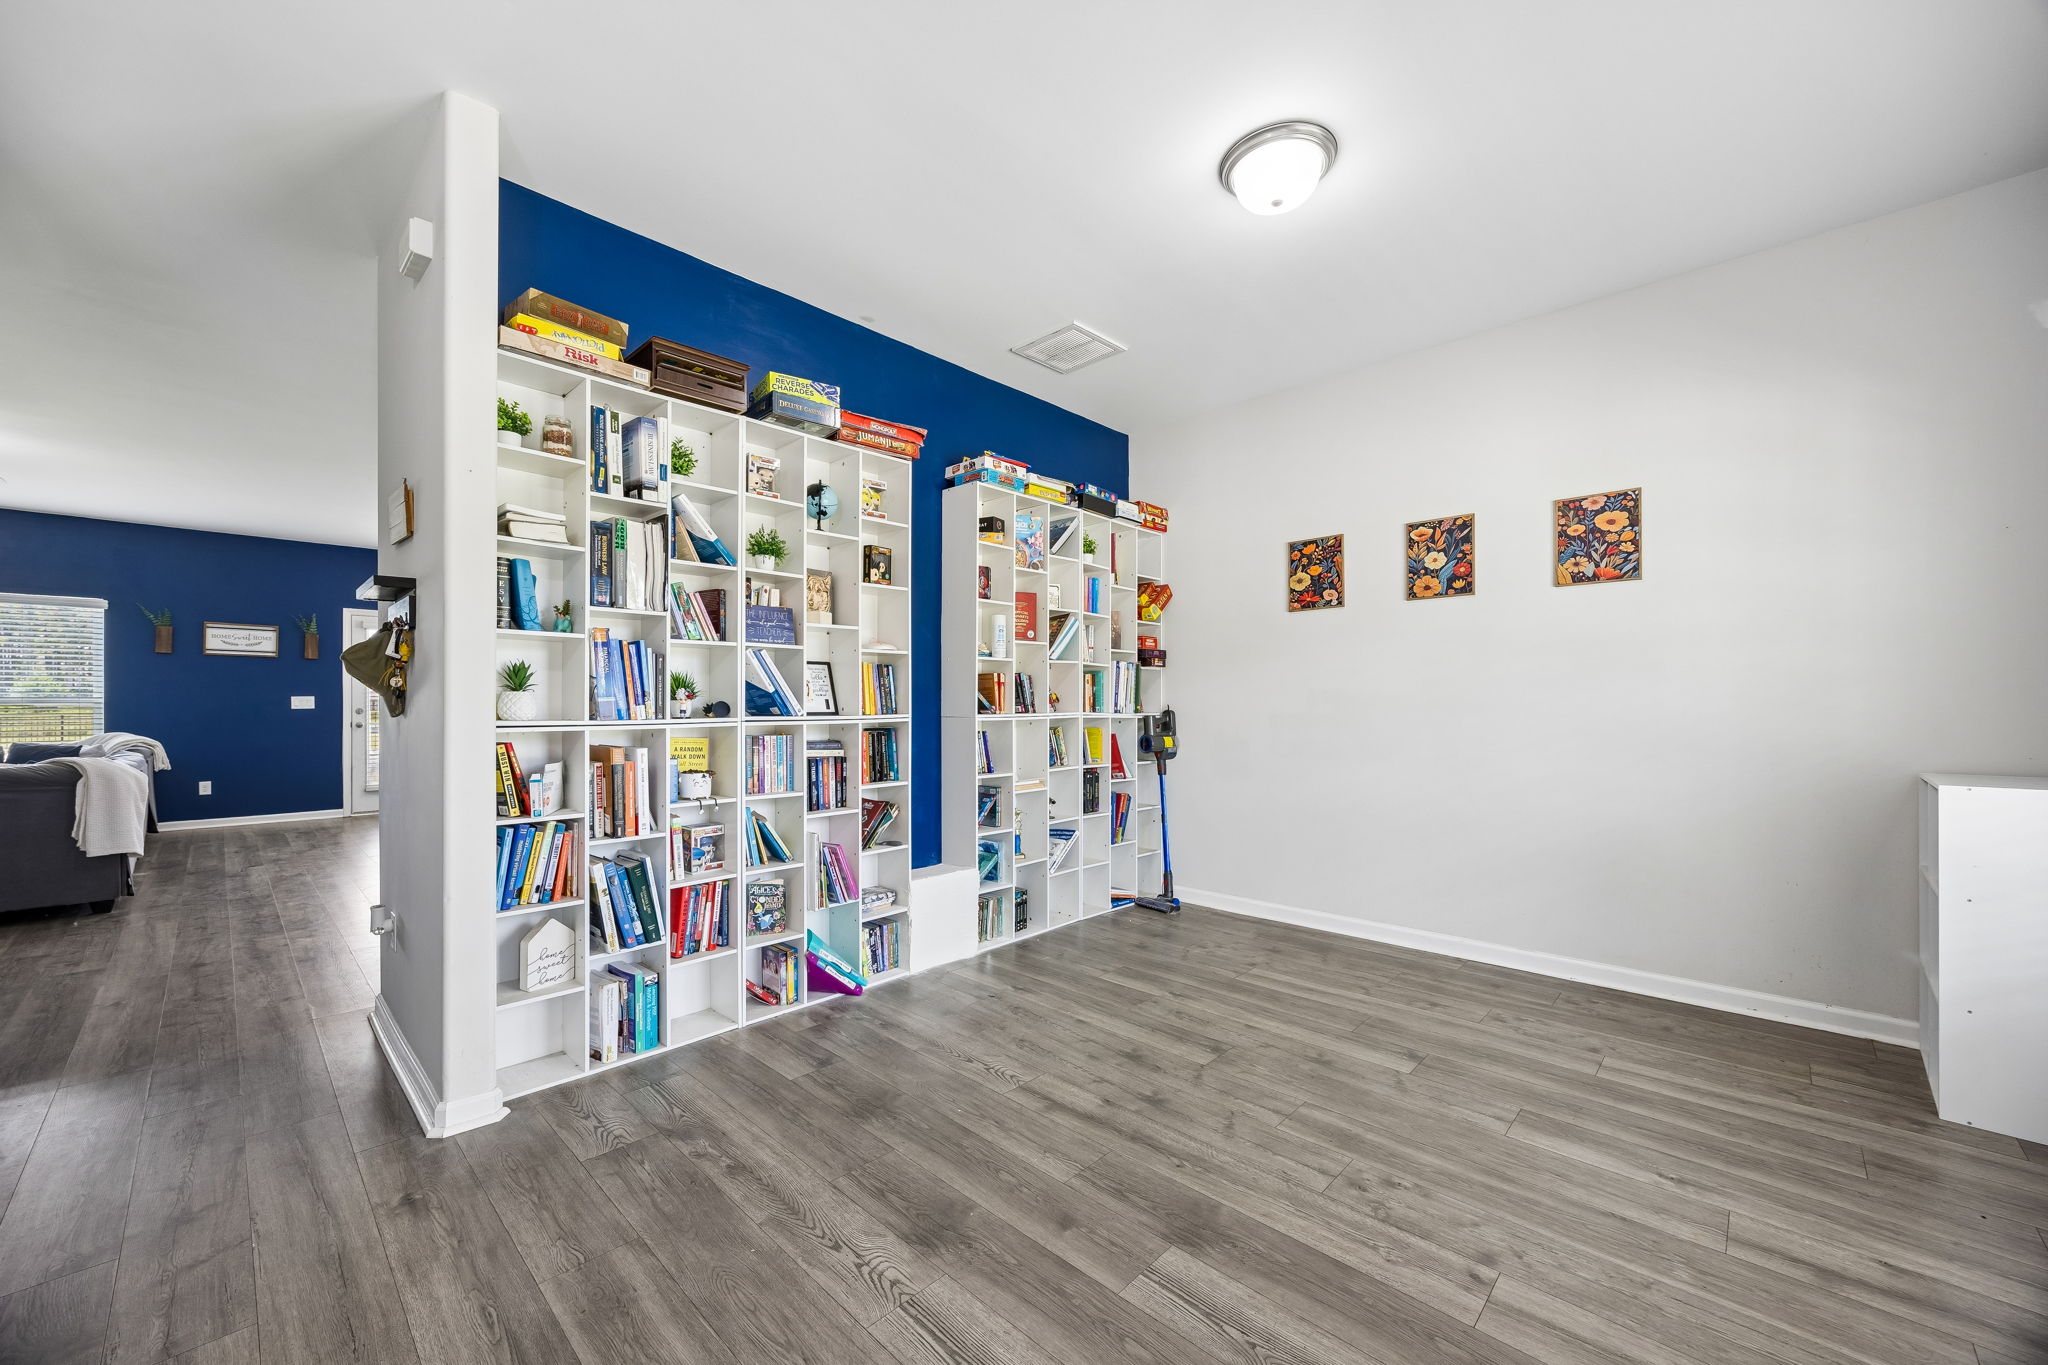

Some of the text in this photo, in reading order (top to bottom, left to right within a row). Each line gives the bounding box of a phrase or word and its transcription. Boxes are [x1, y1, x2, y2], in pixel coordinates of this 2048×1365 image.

[564, 346, 599, 366] Risk
[772, 383, 814, 397] CHARADES
[775, 377, 810, 390] REVERSE
[871, 423, 897, 434] MONOPOLY
[857, 430, 892, 449] JUMANJI
[500, 752, 509, 770] MUST
